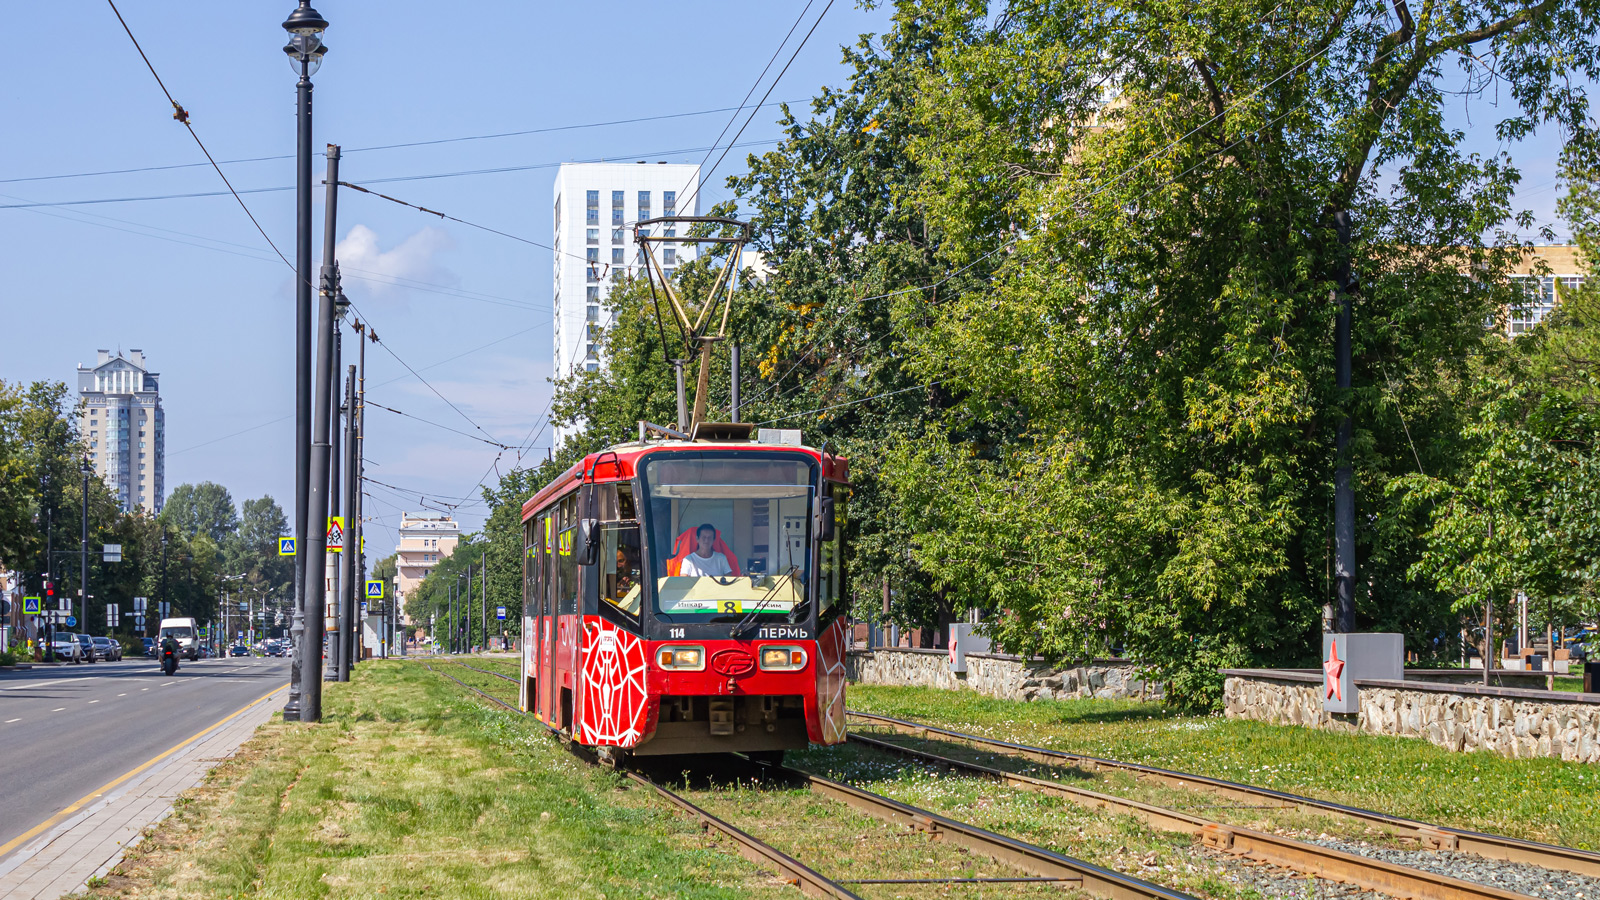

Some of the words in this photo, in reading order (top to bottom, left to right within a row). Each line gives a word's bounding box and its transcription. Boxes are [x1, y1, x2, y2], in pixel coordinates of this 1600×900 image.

[723, 601, 736, 613] 8
[669, 628, 685, 638] 114
[759, 628, 808, 638] ПЕРМЬ
